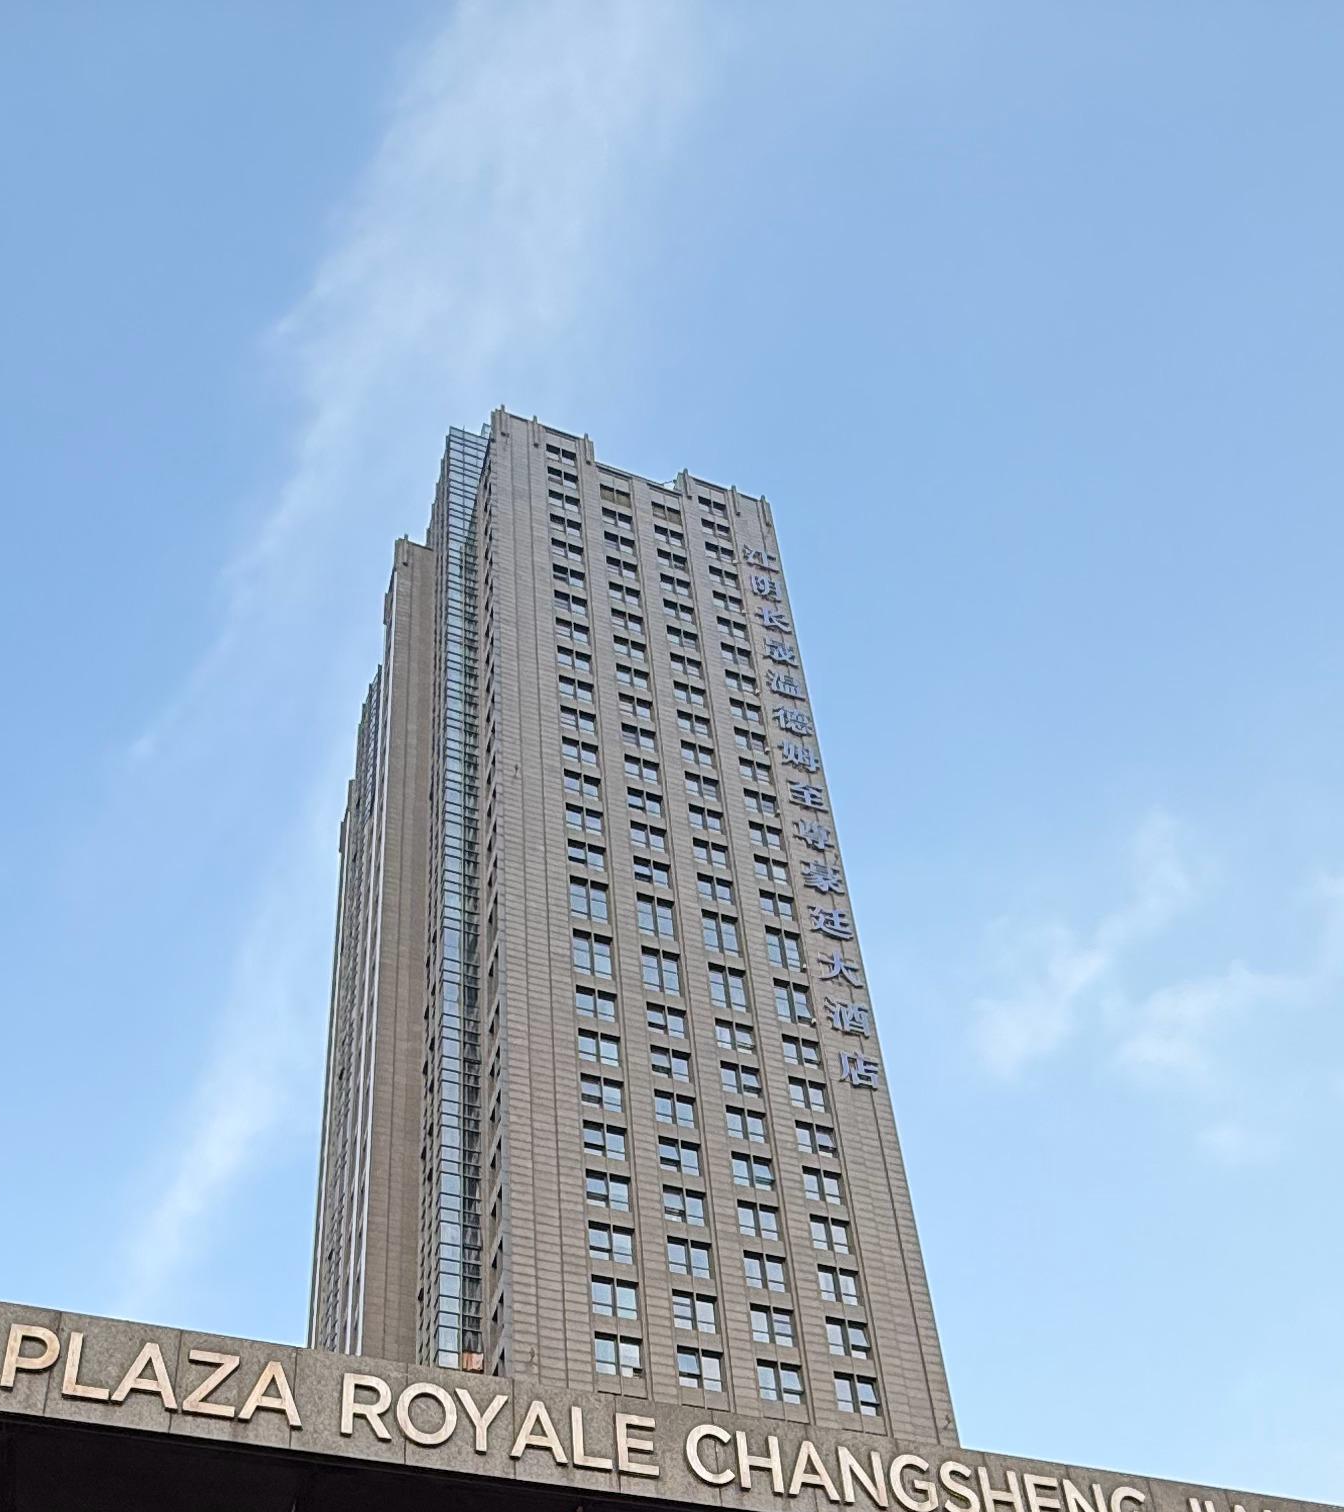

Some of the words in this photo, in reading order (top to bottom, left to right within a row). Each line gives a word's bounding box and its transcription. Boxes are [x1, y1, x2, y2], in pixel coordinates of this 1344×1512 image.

[743, 543, 880, 1091] 江阴长晟温德姆至尊豪廷大酒店
[0, 1322, 303, 1431] PLAZA
[340, 1371, 660, 1479] ROYALE
